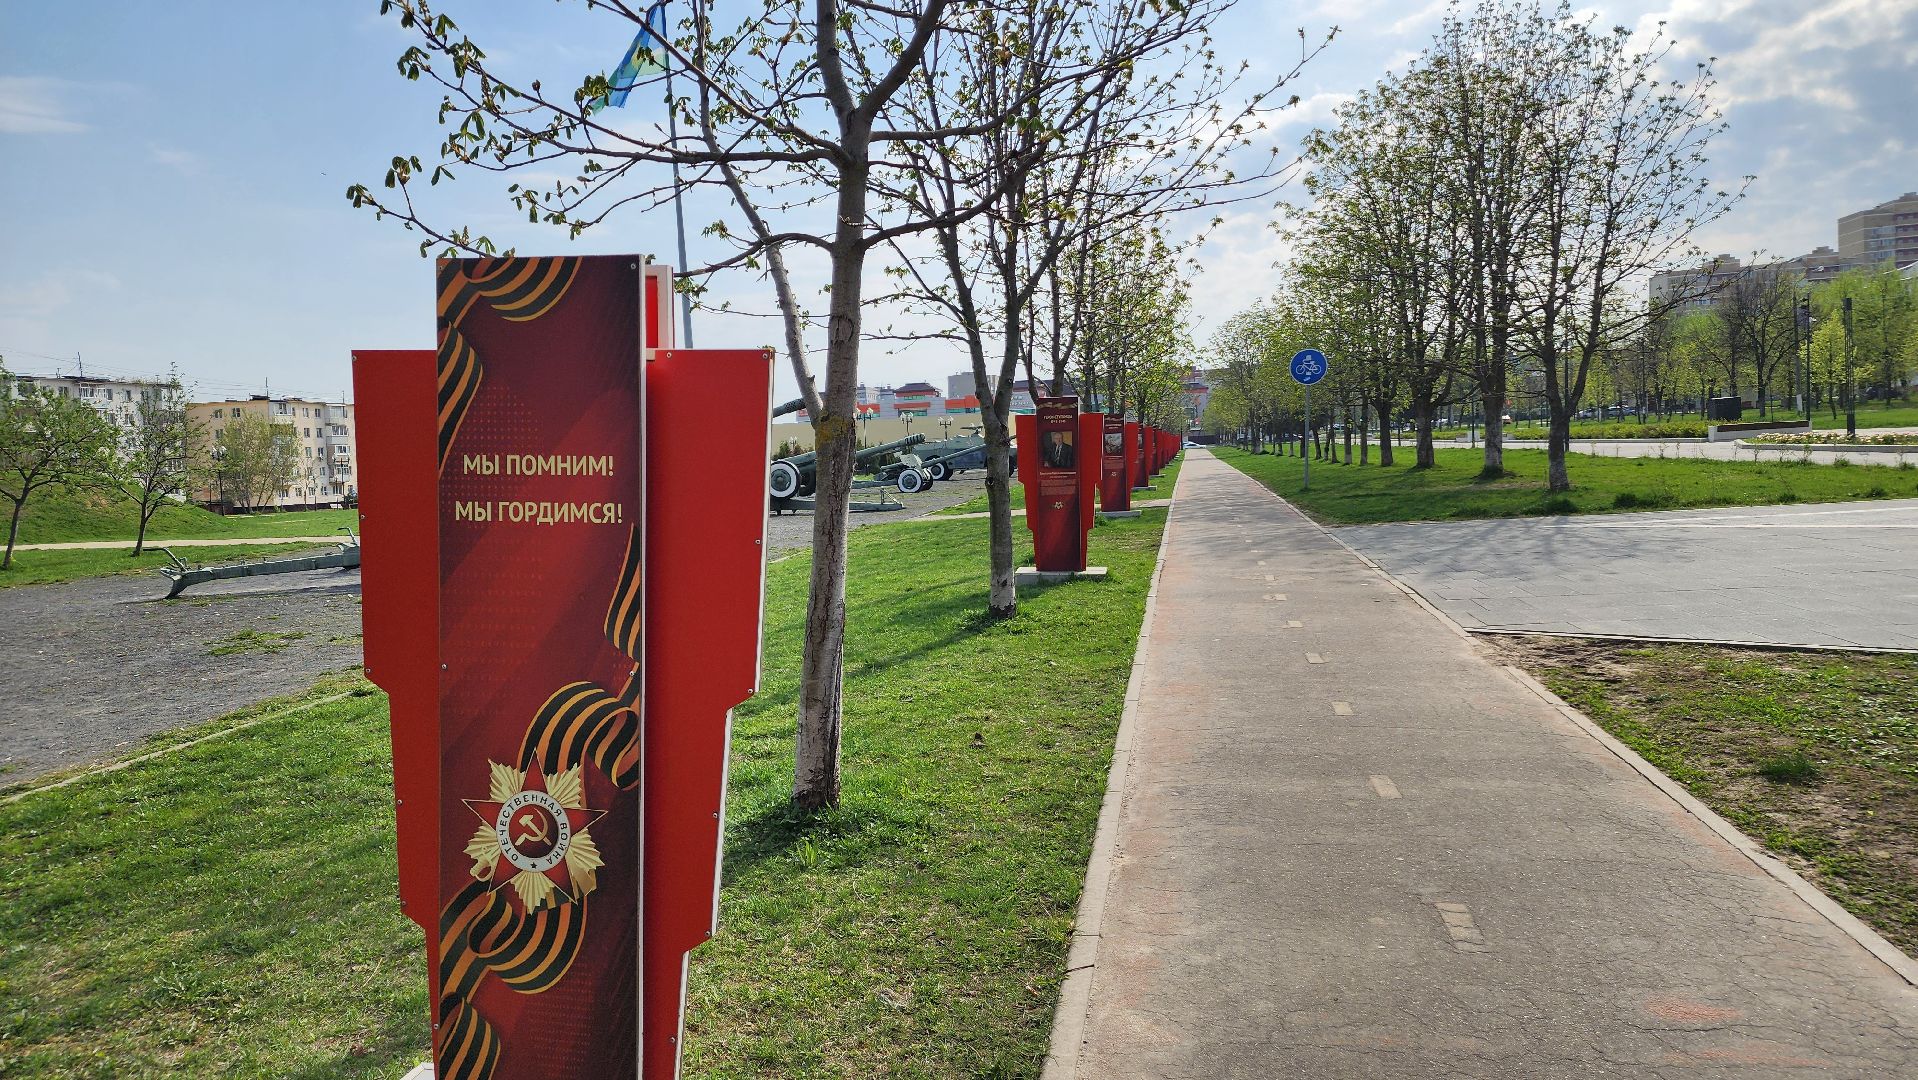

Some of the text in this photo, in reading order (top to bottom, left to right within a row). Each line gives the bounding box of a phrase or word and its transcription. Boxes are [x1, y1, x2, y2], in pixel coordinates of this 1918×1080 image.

[463, 454, 614, 477] МЫ ПОМНИМ!
[455, 500, 623, 526] МЫ ГОРДИМСЯ!
[499, 794, 568, 865] ОТЕЧЕСТВЕННАЯ ВОЙНА
